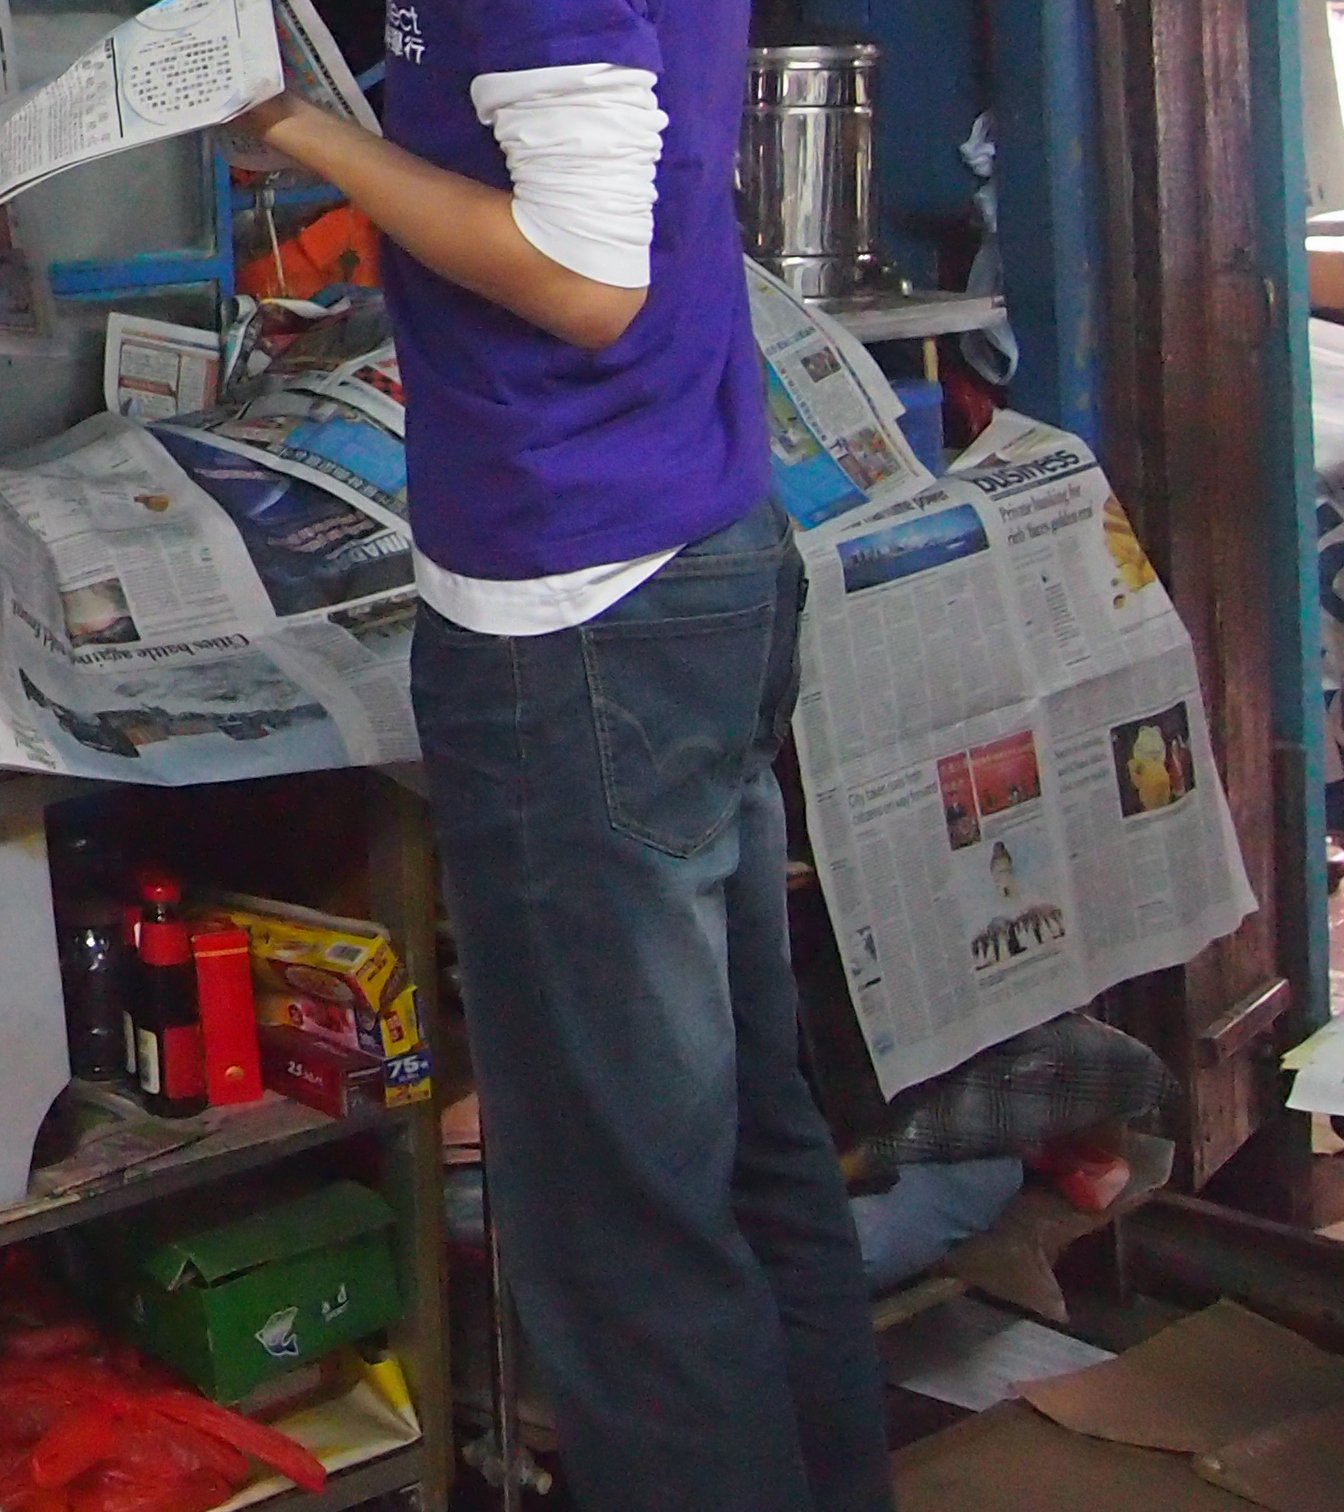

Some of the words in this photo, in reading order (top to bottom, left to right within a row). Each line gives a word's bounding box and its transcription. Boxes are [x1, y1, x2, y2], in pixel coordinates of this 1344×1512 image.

[973, 449, 1080, 494] business
[137, 642, 193, 659] battle
[194, 633, 250, 651] Cities
